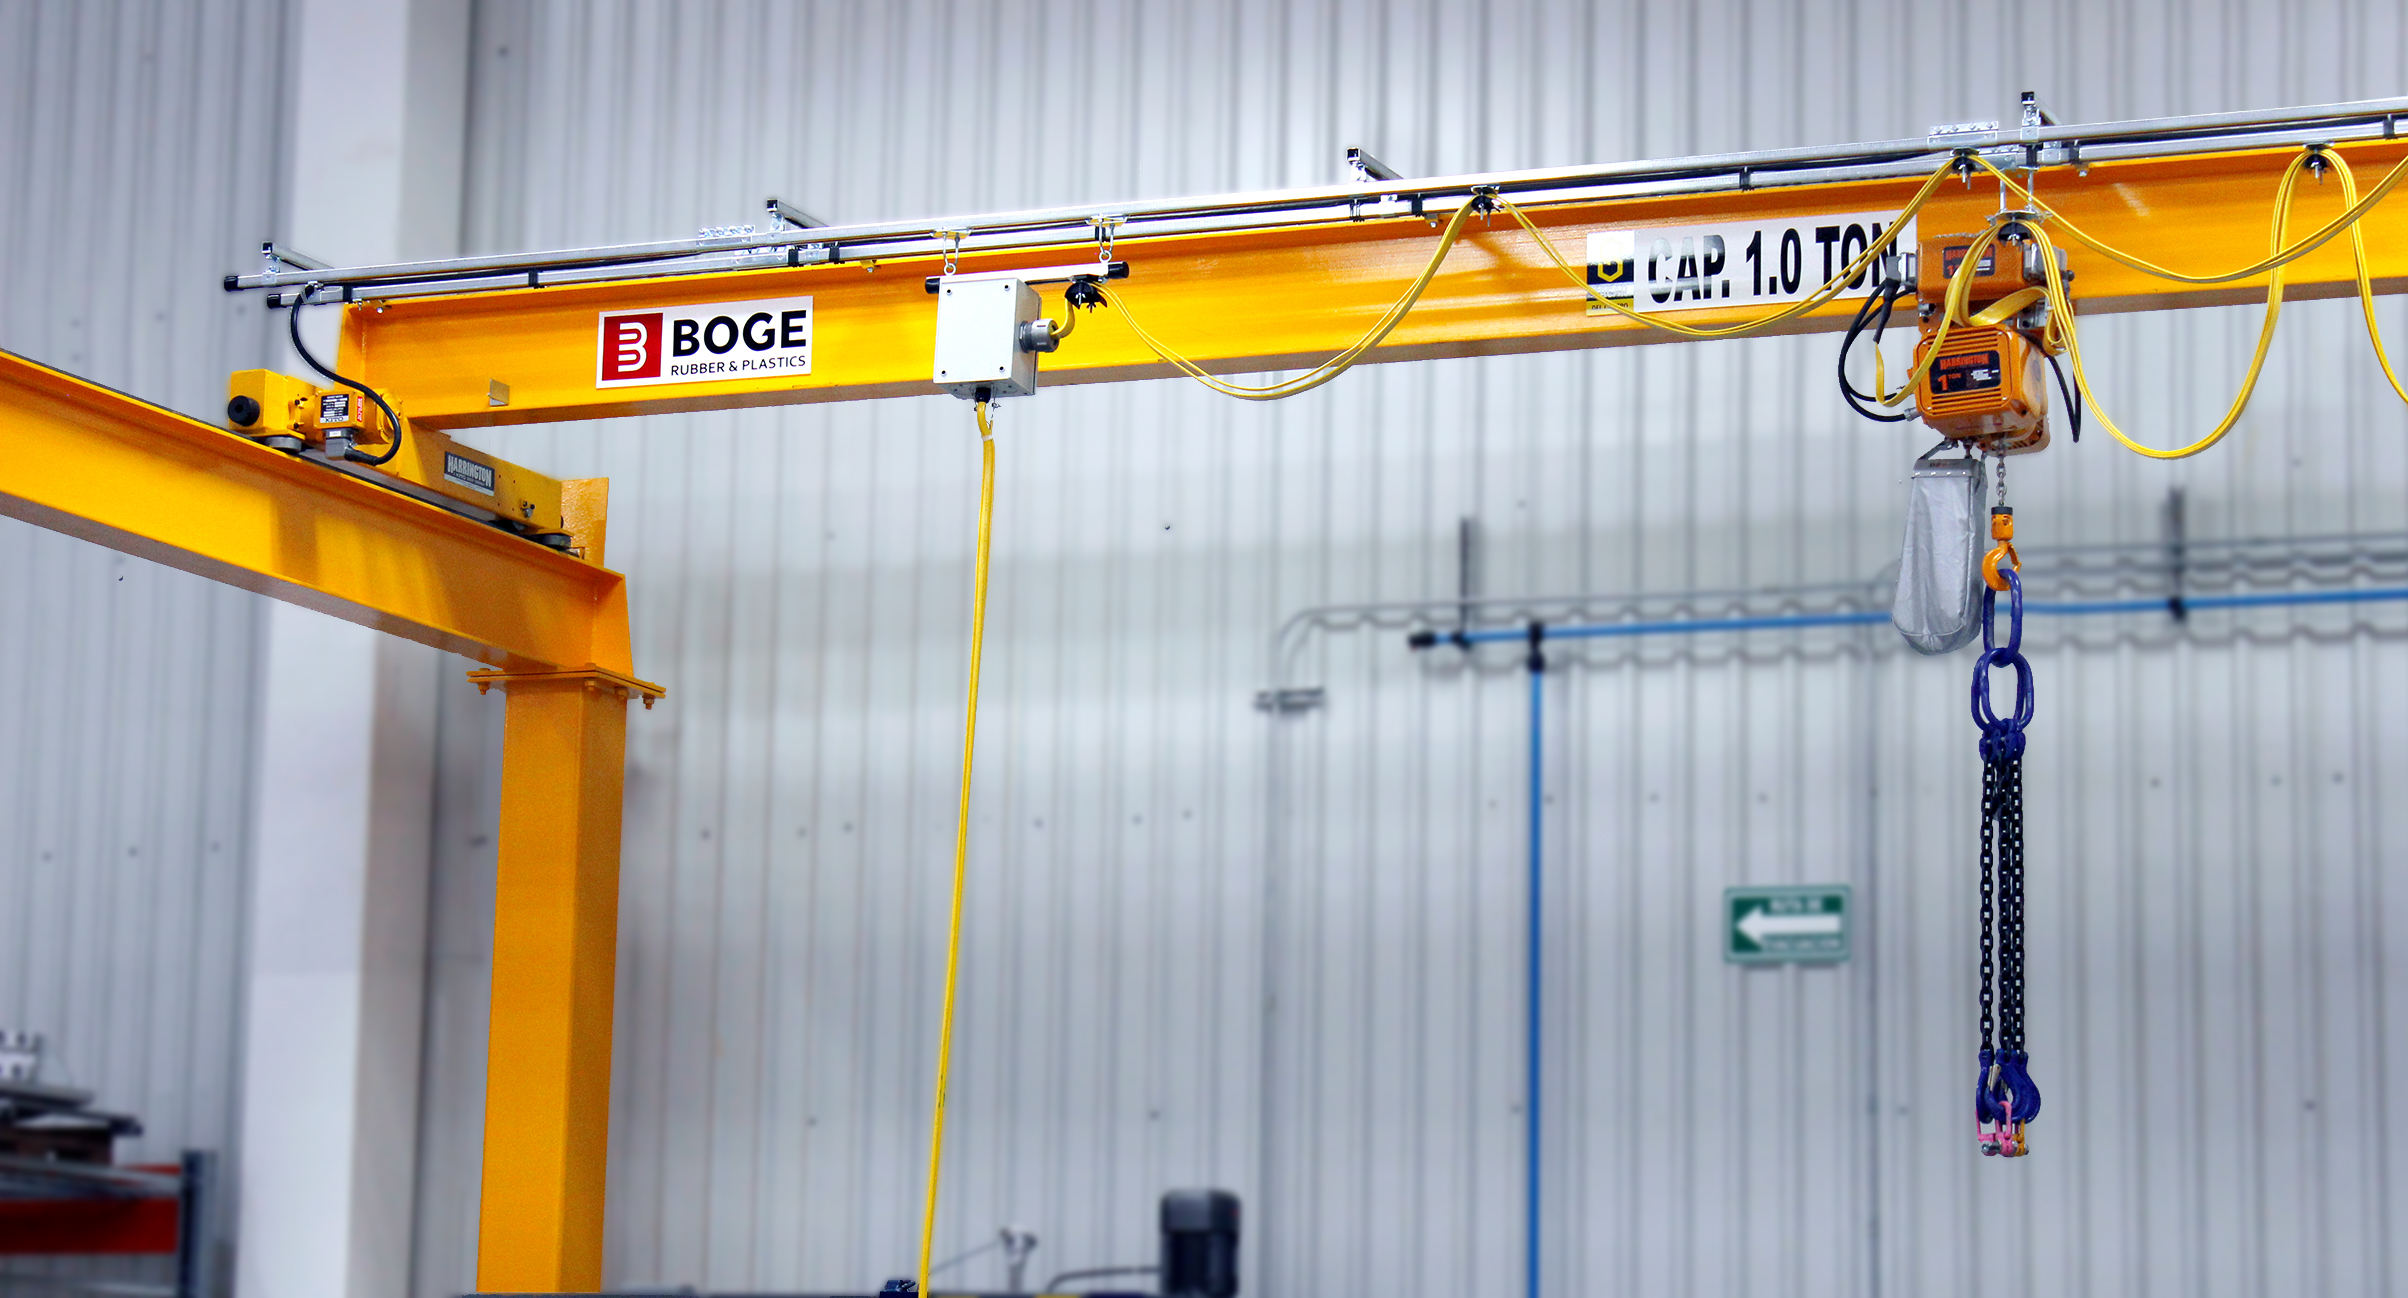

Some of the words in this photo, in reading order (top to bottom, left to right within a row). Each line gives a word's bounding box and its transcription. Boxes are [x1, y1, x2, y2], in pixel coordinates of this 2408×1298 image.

[1647, 234, 1730, 304] CAP.
[1745, 228, 1802, 296] 1.0
[1815, 221, 1898, 291] TON
[672, 309, 807, 357] BOGE
[671, 361, 725, 376] RUBBER
[728, 361, 738, 372] &
[742, 355, 806, 371] PLASTICS
[1939, 353, 1989, 370] HARRINGTON
[1937, 374, 1949, 391] 1
[447, 454, 492, 488] HARRINGTON
